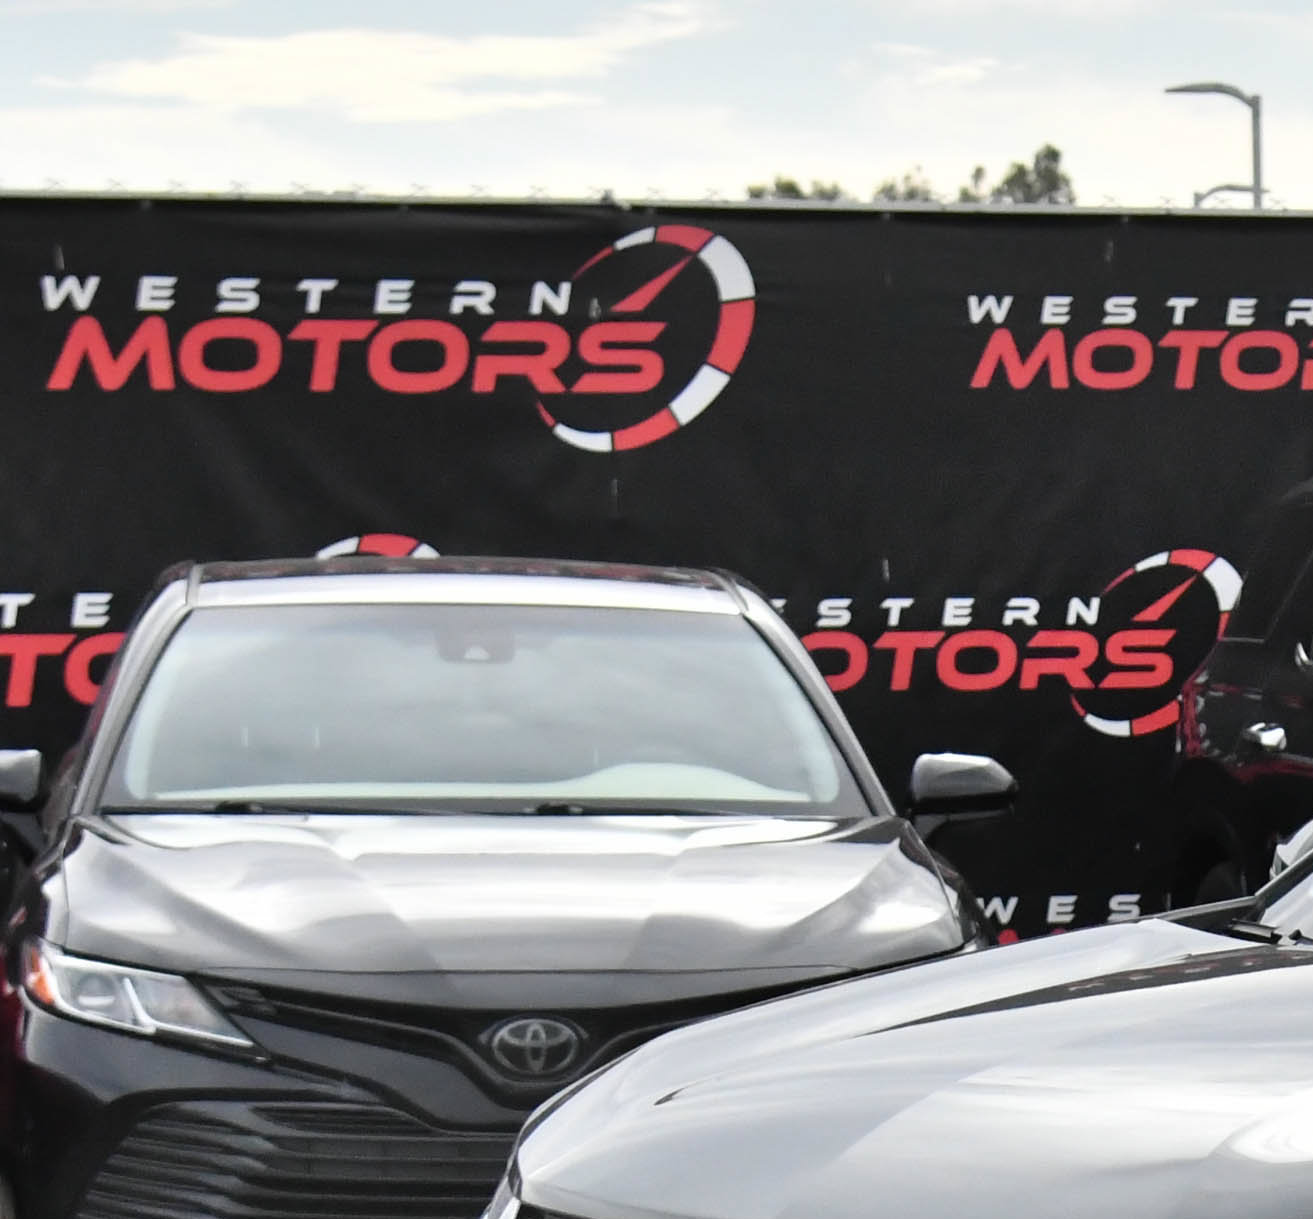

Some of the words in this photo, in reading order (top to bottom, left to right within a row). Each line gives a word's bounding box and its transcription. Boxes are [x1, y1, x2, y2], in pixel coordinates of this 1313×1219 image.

[41, 275, 572, 316] WESTERN
[47, 315, 667, 394] MOTORS
[769, 596, 1101, 628] STERN
